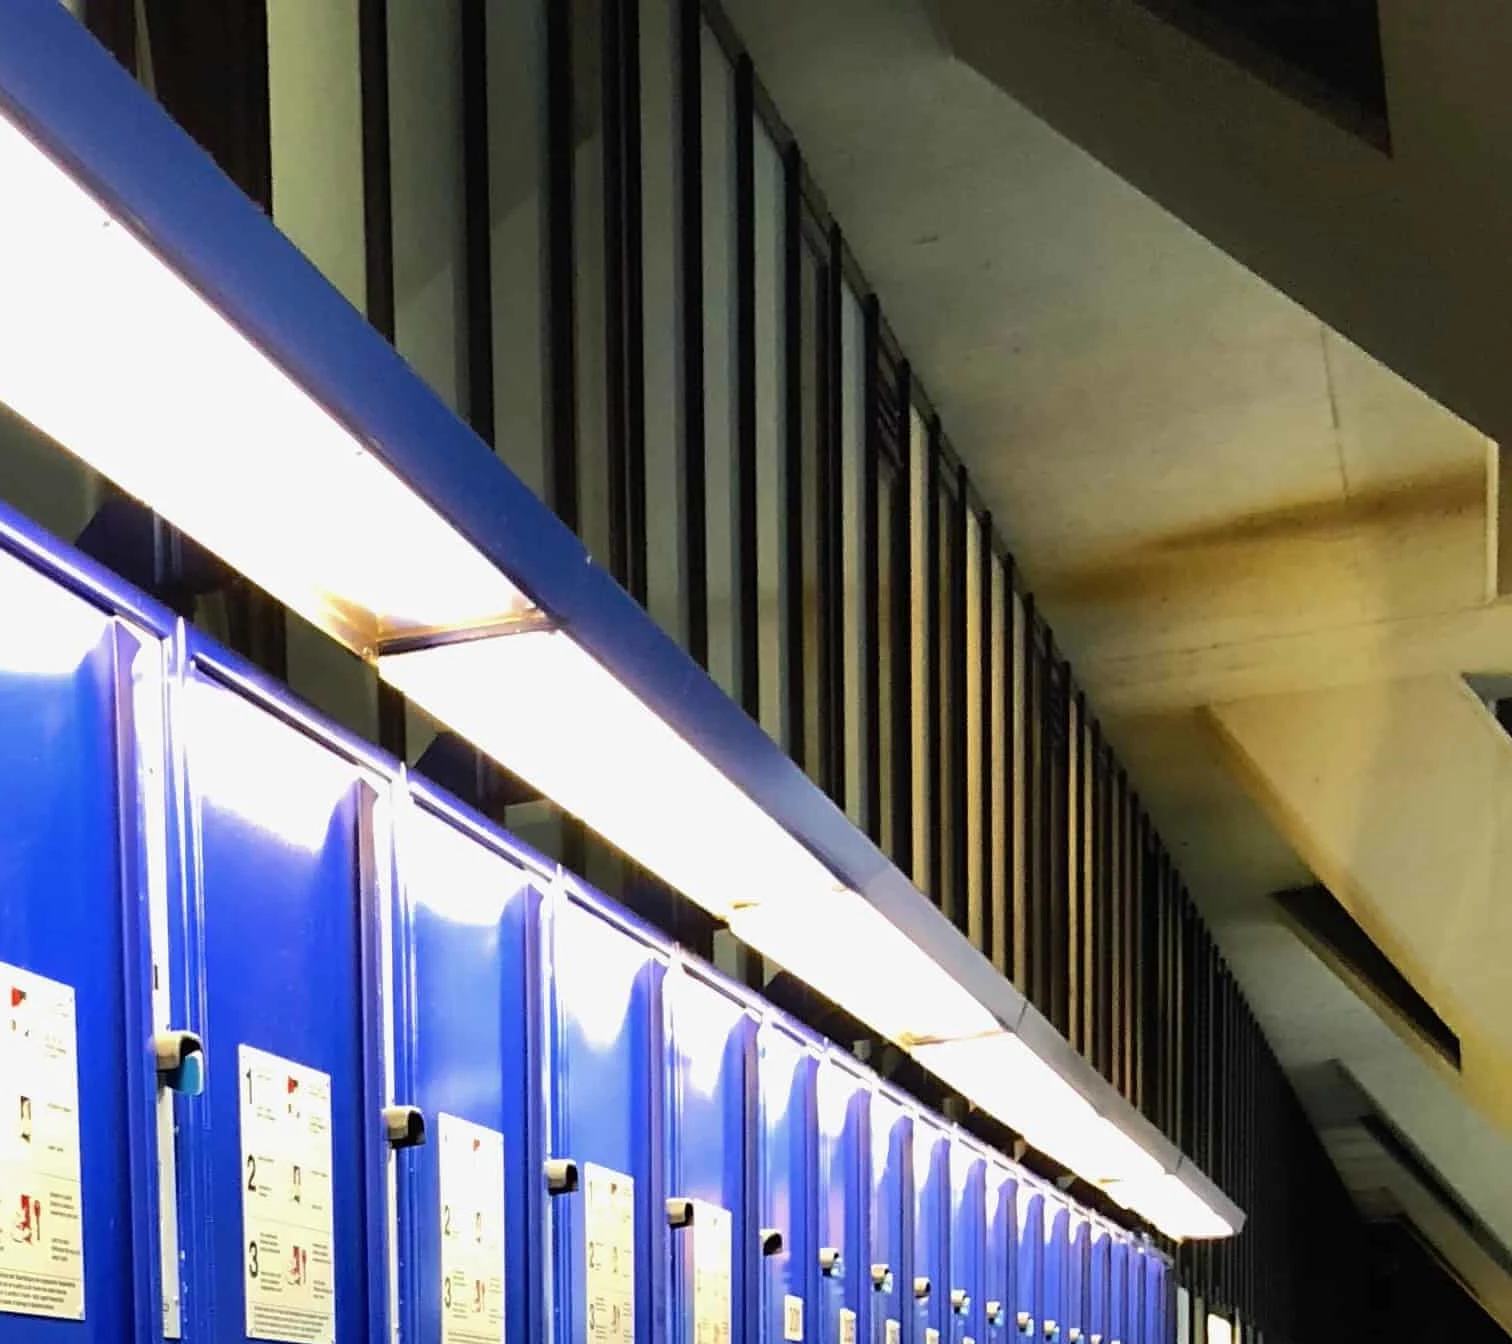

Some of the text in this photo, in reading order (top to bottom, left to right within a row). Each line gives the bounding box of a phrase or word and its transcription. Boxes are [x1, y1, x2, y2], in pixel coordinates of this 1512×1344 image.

[246, 1067, 253, 1105] 1
[247, 1154, 258, 1192] 2
[248, 1241, 260, 1279] 3
